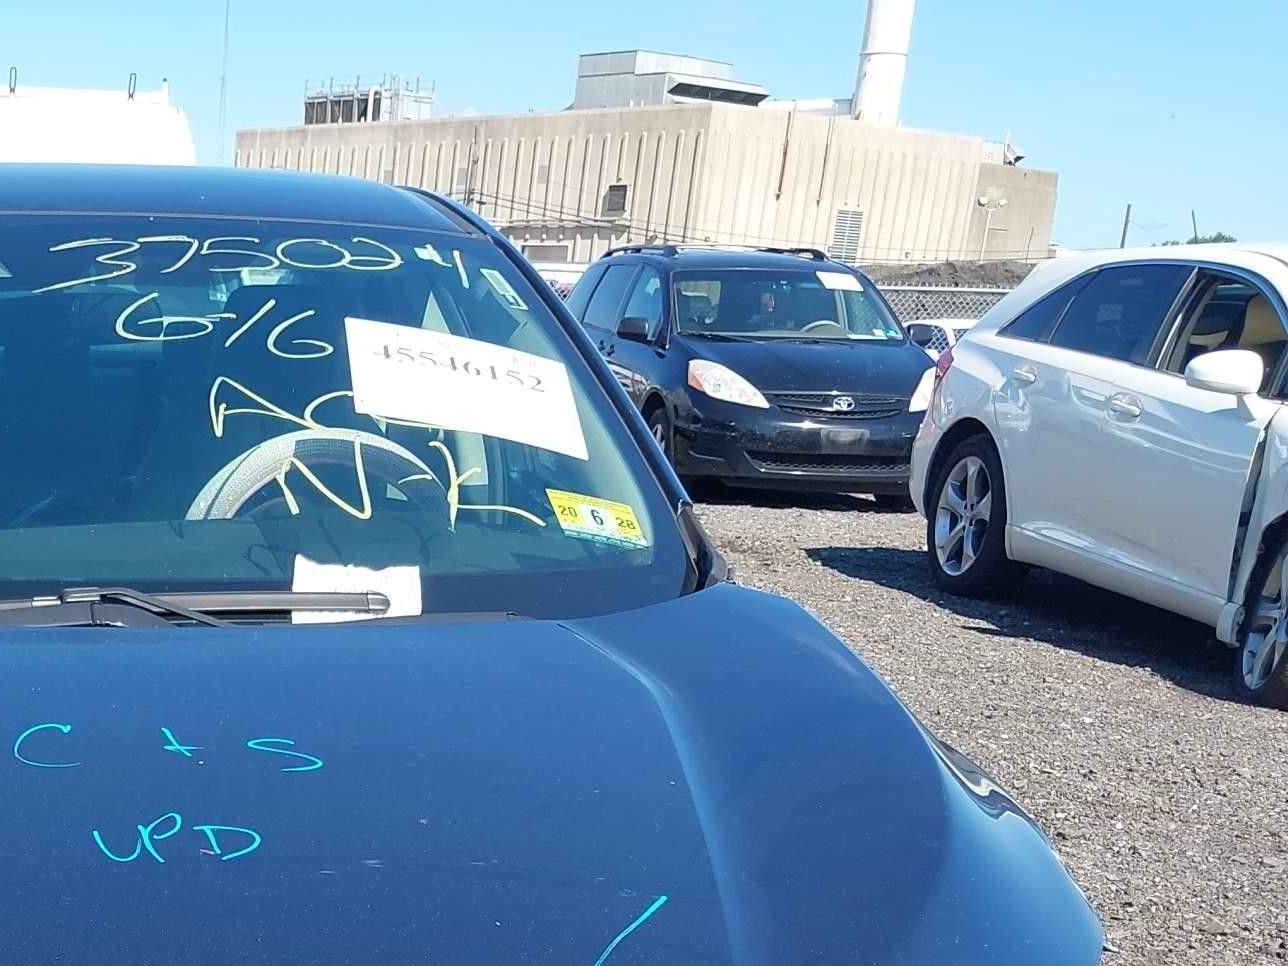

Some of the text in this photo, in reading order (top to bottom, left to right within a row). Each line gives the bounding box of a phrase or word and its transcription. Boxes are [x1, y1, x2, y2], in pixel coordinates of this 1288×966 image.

[373, 343, 547, 394] 45546152
[557, 504, 637, 530] 20 6 28
[13, 722, 81, 768] C
[247, 737, 324, 772] S
